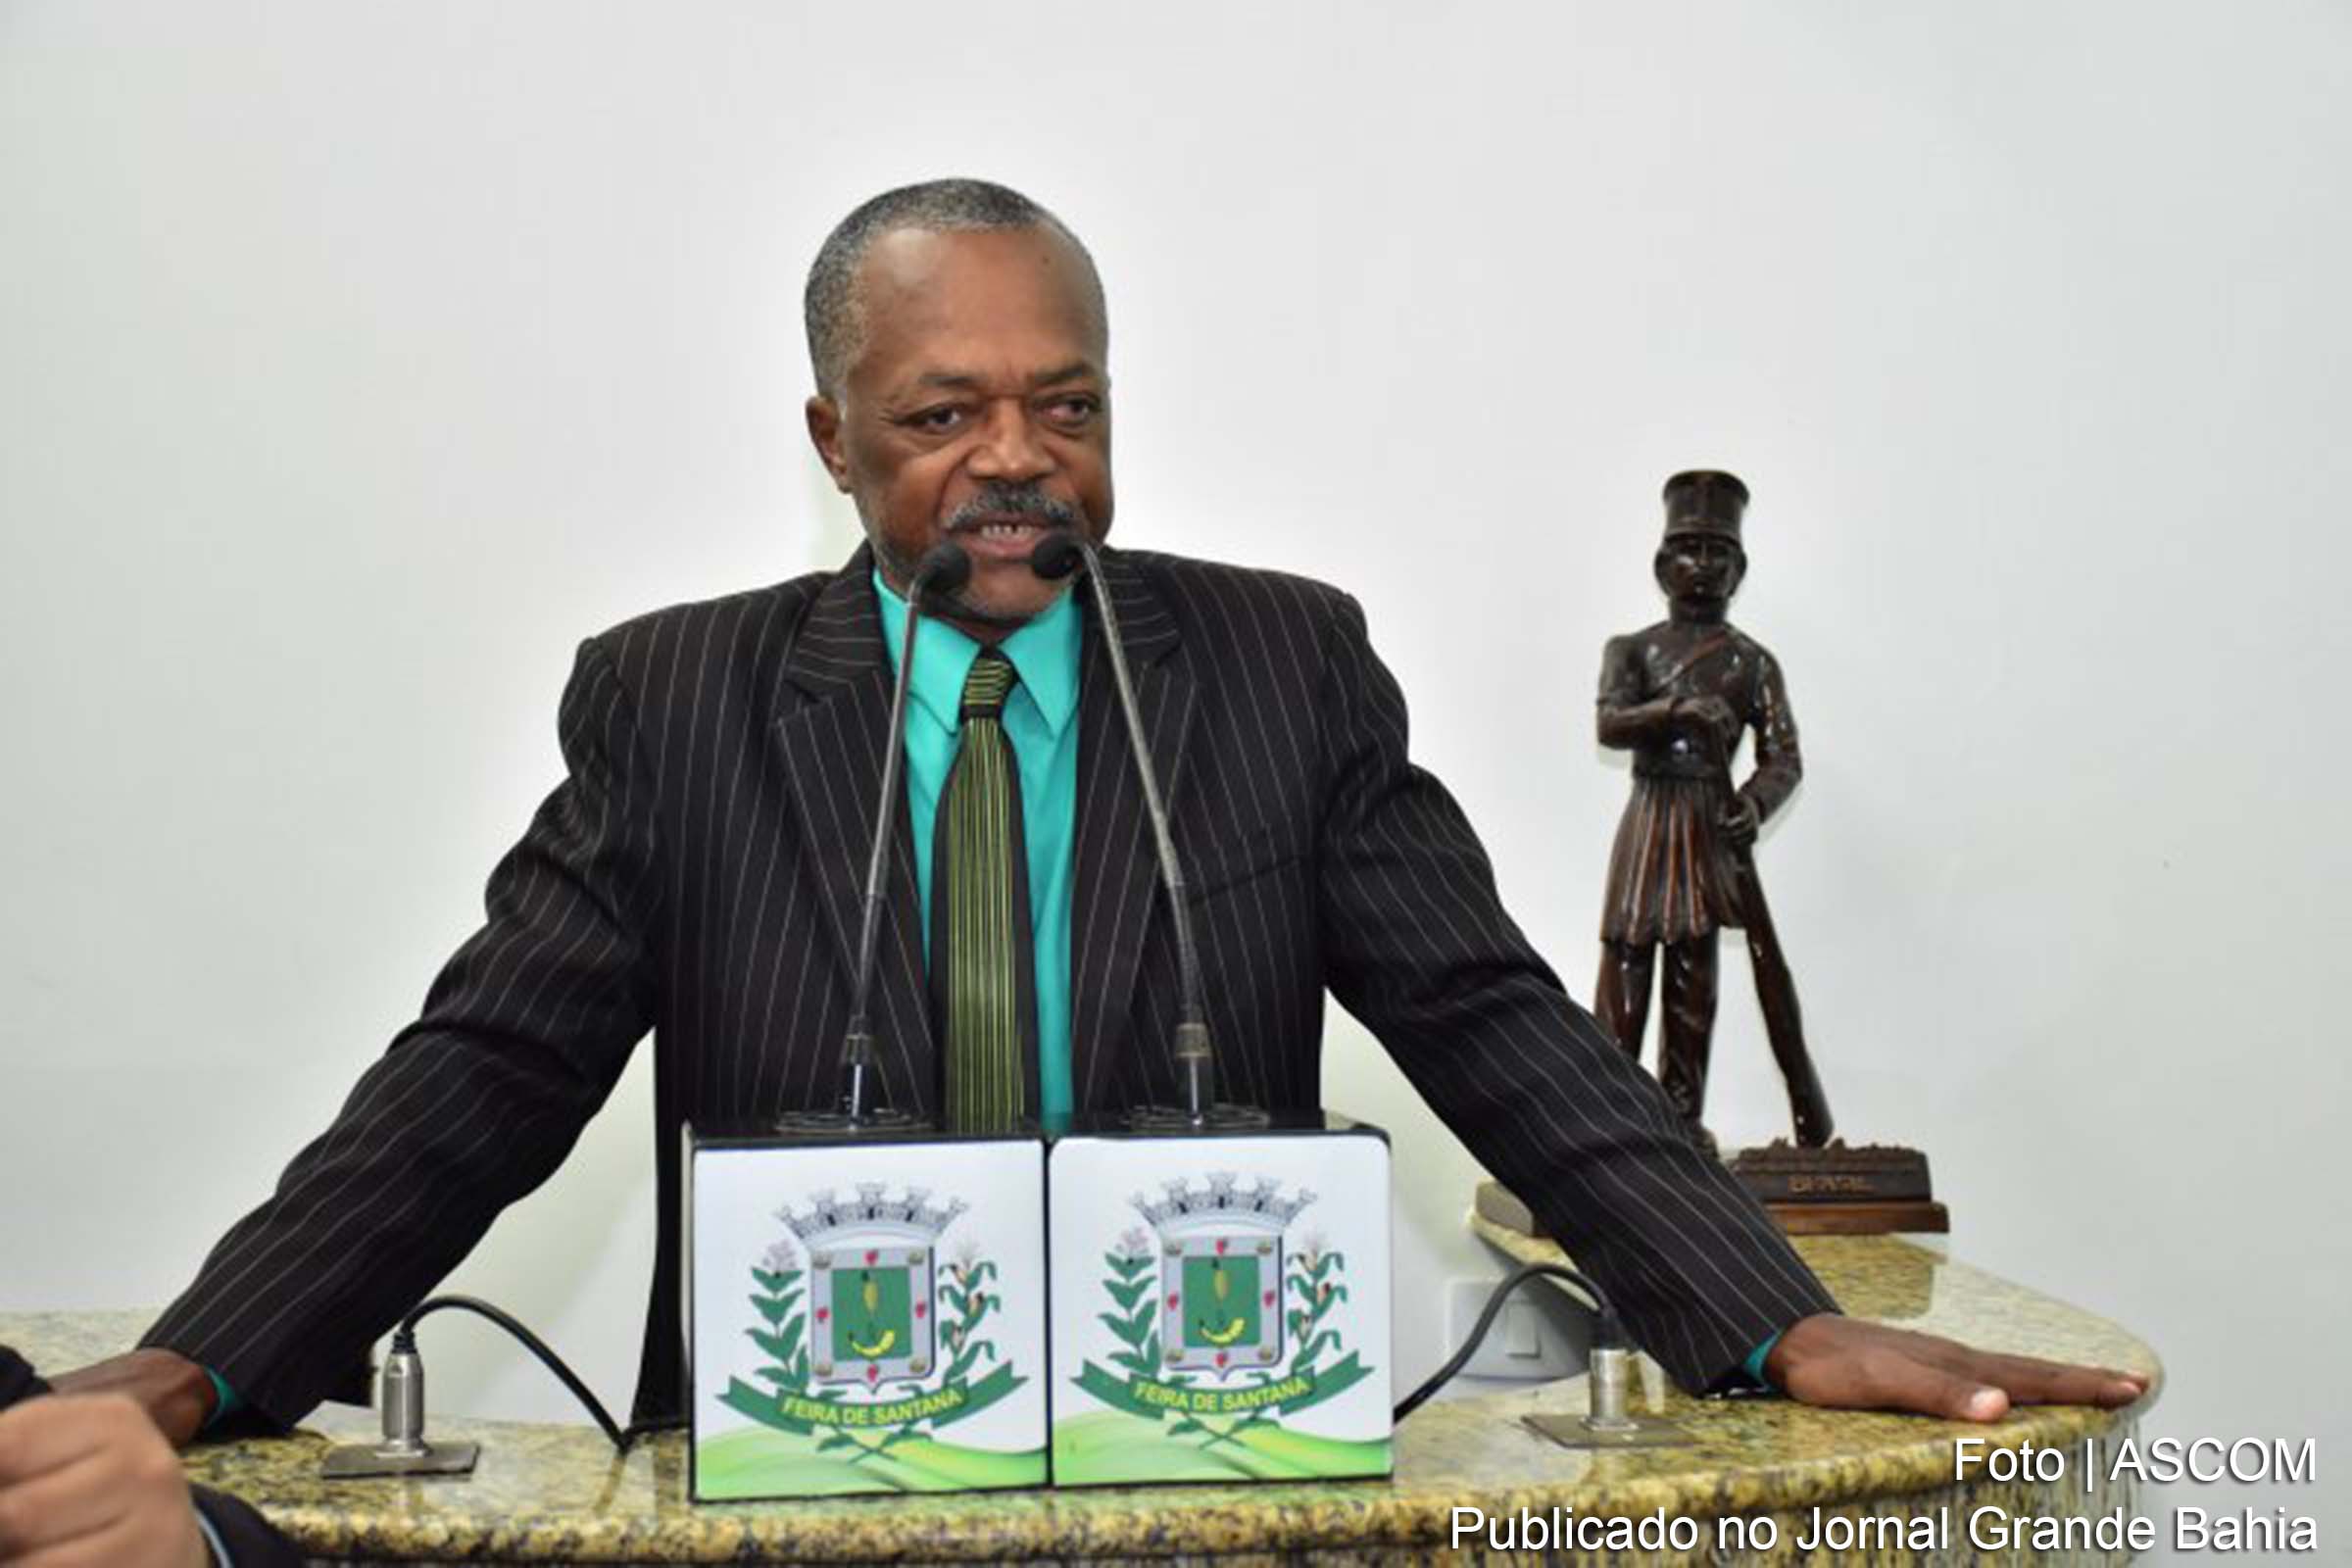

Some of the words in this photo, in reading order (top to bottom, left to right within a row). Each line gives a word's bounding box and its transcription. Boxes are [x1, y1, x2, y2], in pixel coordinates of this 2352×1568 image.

[782, 1396, 839, 1424] FEIRA
[843, 1405, 867, 1424] DE
[875, 1389, 962, 1424] SANTANA
[1134, 1381, 1190, 1411] FEIRA
[1192, 1393, 1218, 1412] DE
[1222, 1376, 1309, 1409] SANTANA
